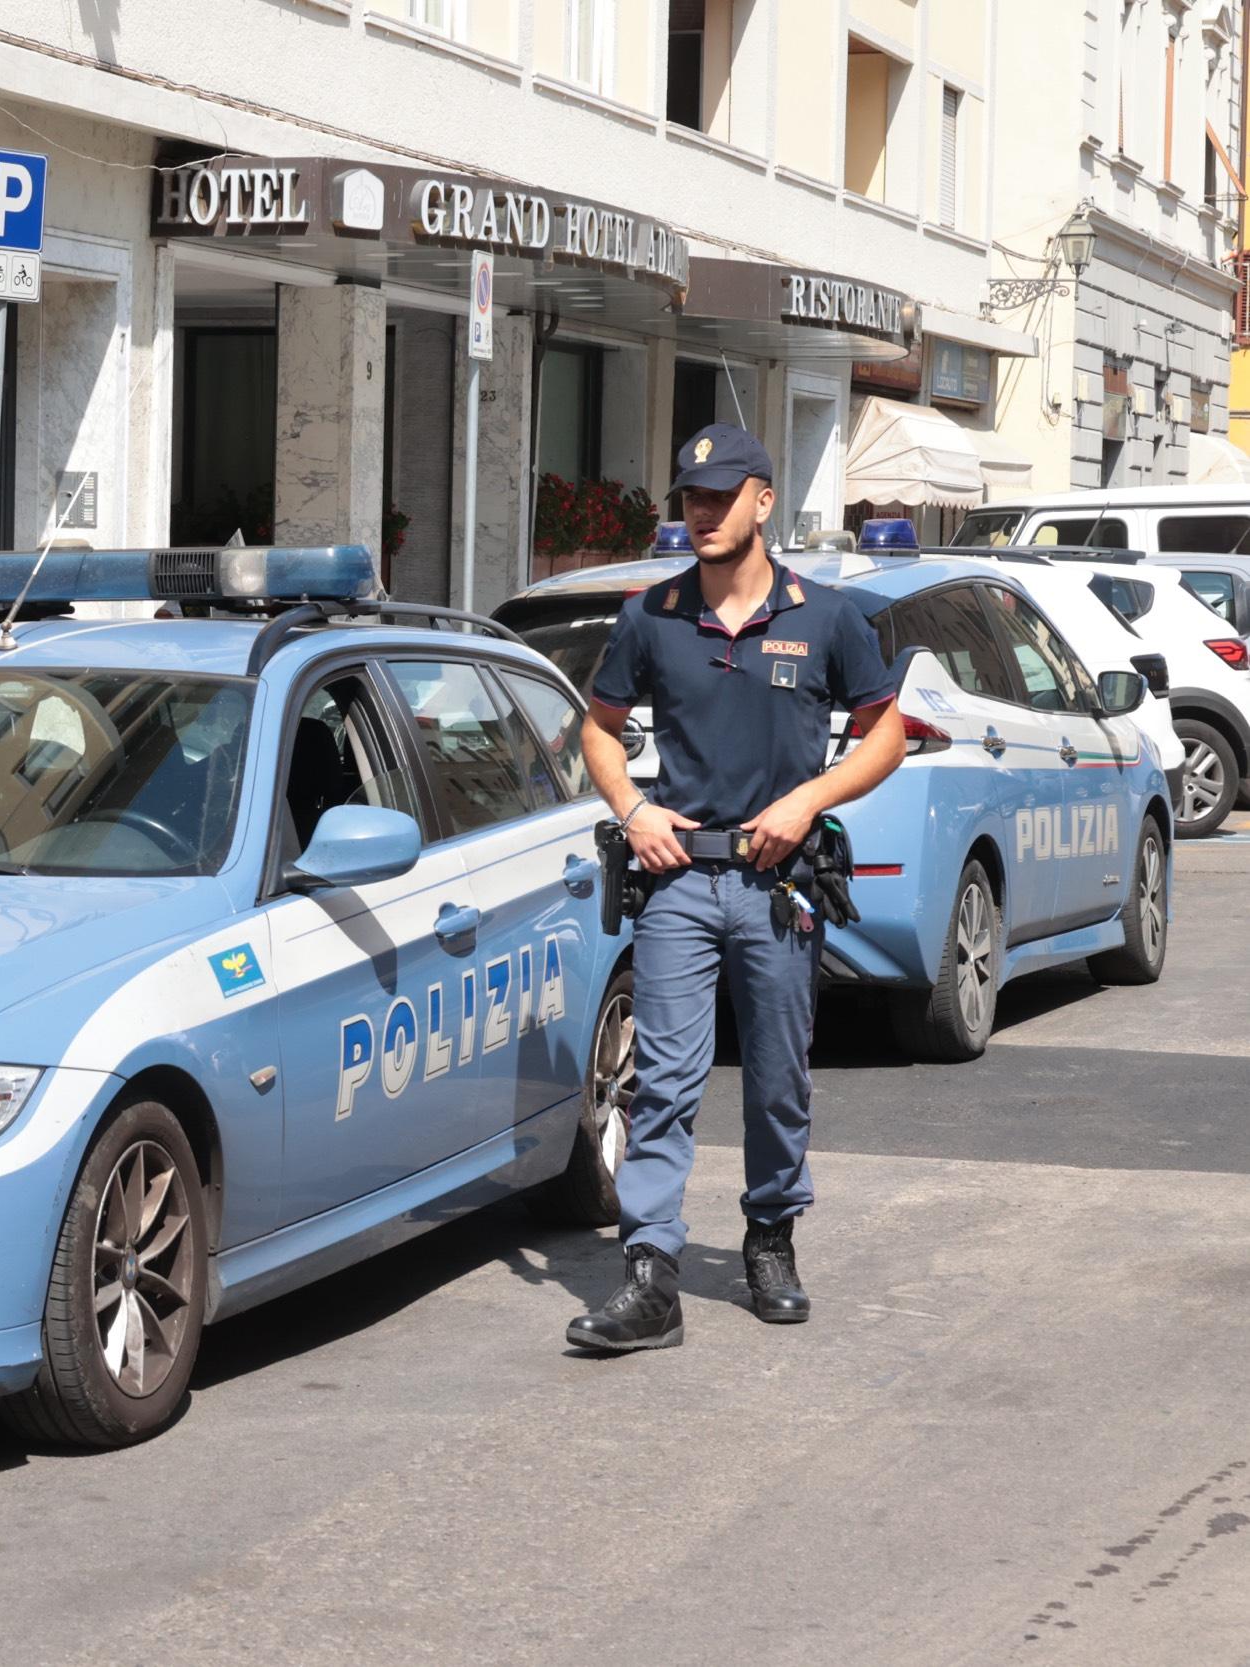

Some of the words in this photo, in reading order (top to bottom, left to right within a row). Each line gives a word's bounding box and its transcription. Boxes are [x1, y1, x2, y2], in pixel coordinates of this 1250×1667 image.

[157, 168, 306, 226] HOTEL
[420, 179, 550, 249] GRAND
[565, 203, 638, 267] HOTEL
[790, 274, 902, 334] RISTORANTE
[366, 360, 373, 380] 9
[480, 390, 497, 402] 23
[764, 641, 807, 655] POLIZIA
[1016, 804, 1119, 863] POLIZIA
[335, 932, 565, 1122] POLIZIA
